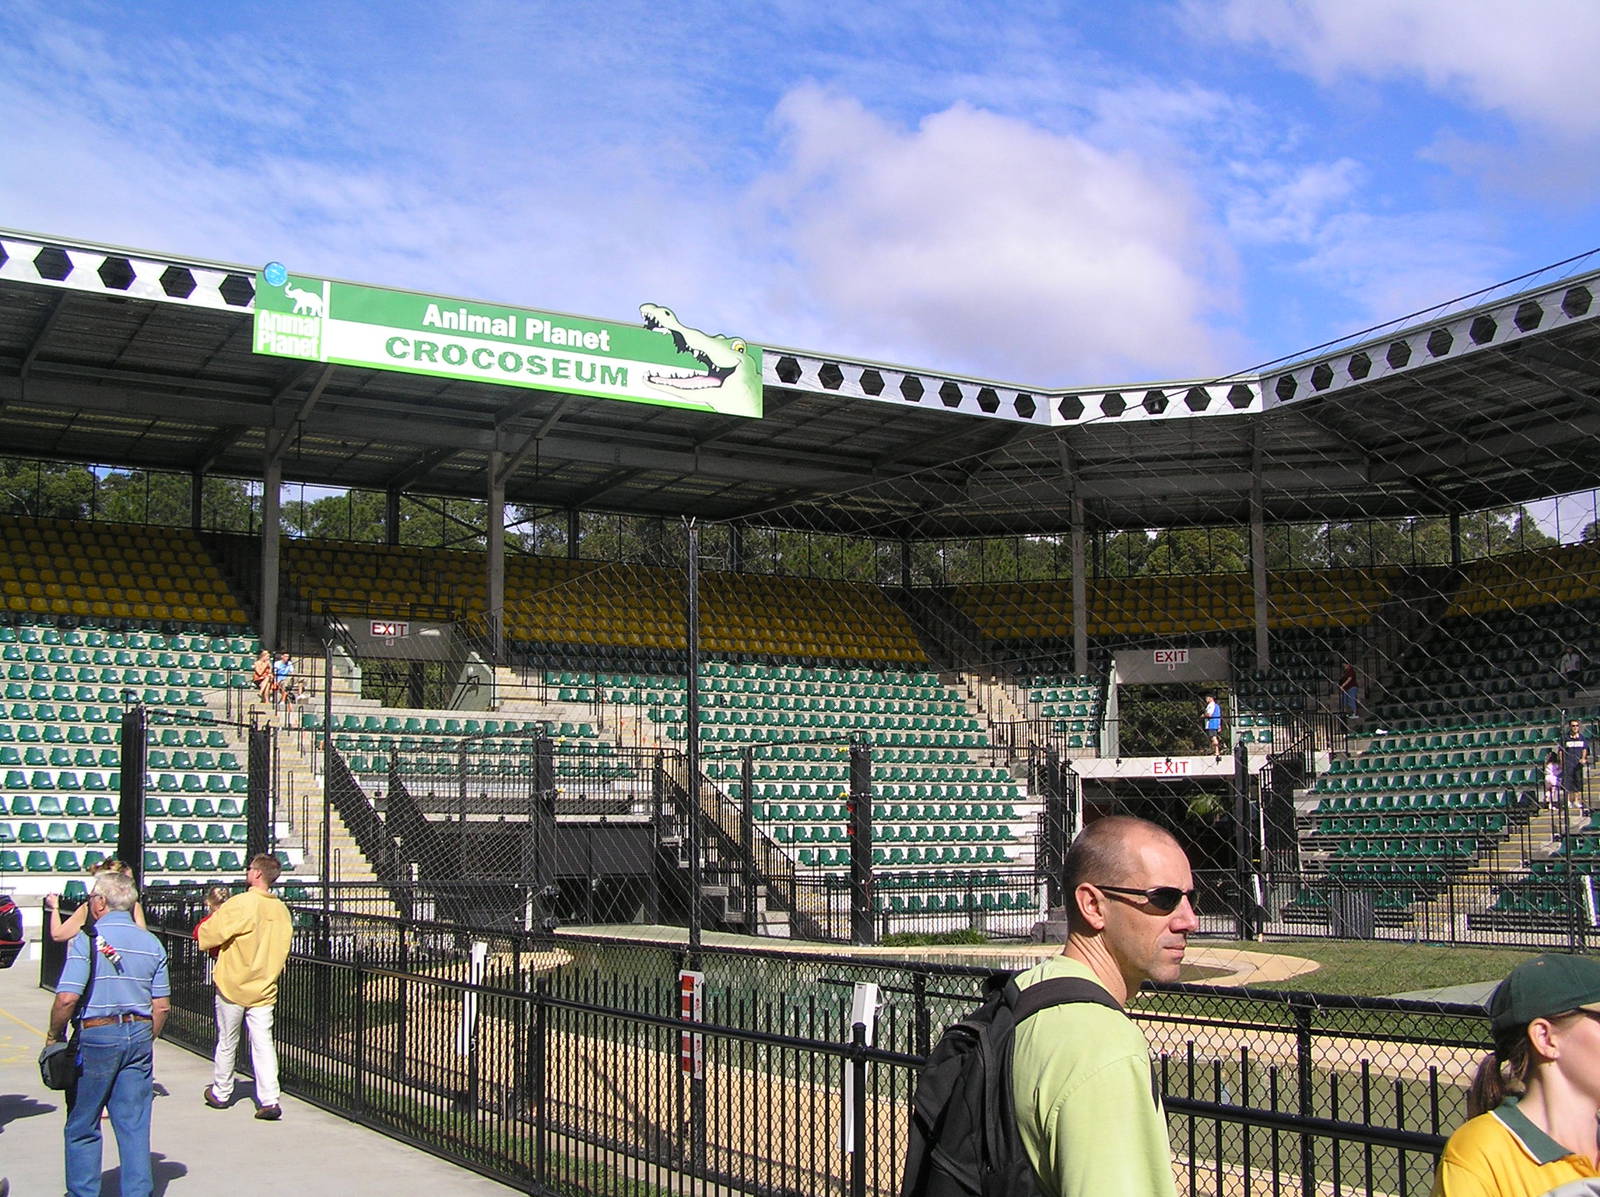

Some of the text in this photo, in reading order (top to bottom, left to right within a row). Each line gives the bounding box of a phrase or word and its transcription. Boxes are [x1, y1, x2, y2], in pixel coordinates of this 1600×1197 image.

[258, 309, 320, 337] Animal
[422, 303, 611, 352] Animal Planet
[256, 330, 320, 358] Planet
[385, 336, 629, 387] CROCOSEUM
[372, 622, 407, 636] EXIT
[1155, 651, 1186, 662] EXIT
[1153, 761, 1189, 774] EXIT
